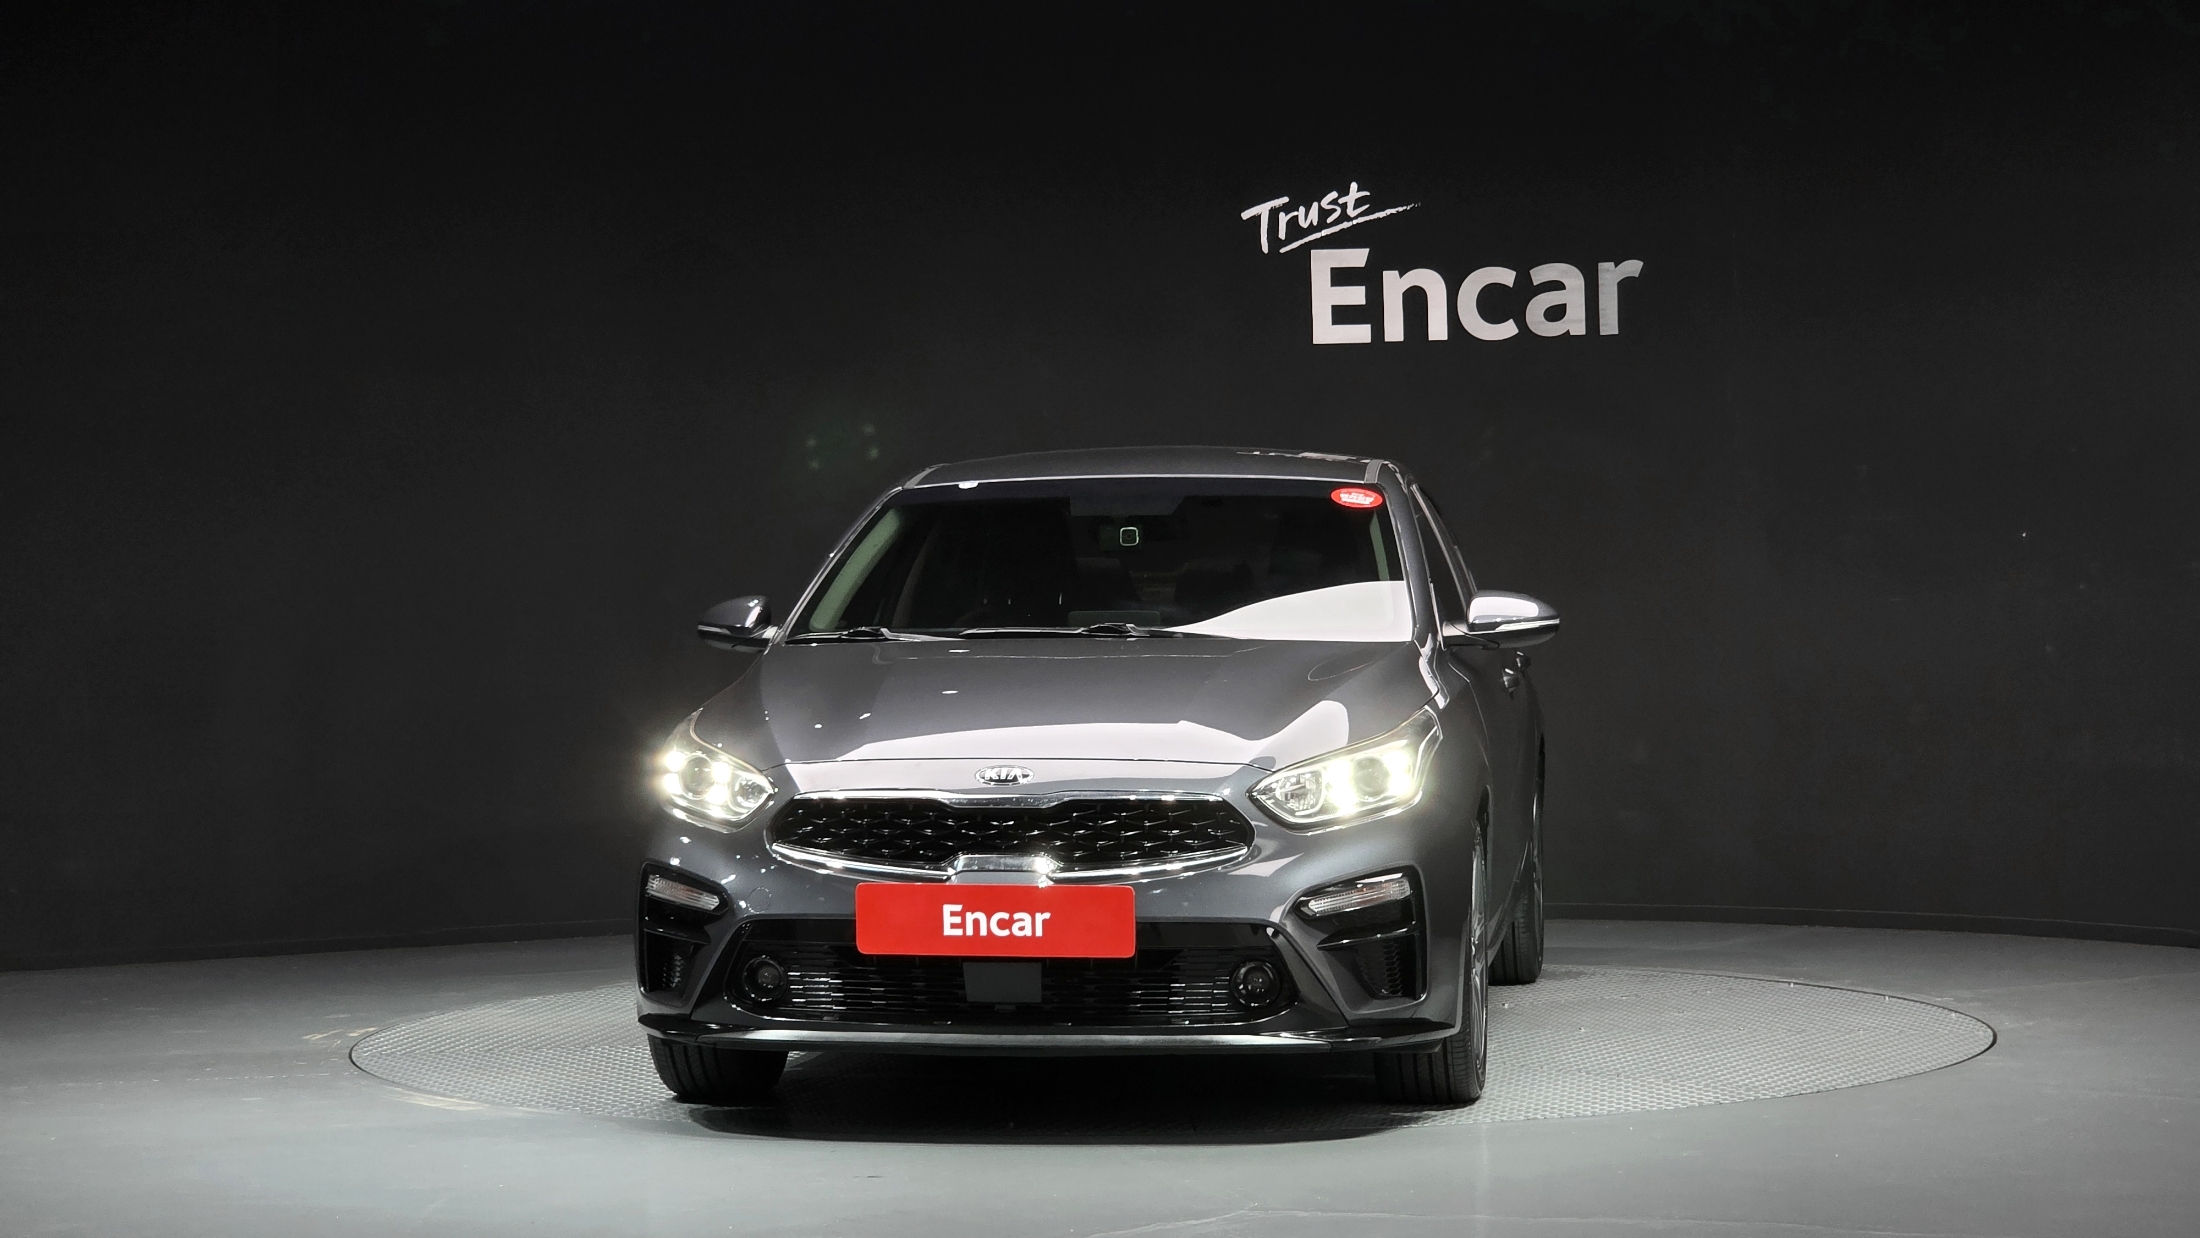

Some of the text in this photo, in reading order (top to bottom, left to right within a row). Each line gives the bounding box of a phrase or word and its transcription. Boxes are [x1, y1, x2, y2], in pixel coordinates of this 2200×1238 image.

[1241, 181, 1371, 254] Trust
[1310, 247, 1644, 345] Encar
[984, 767, 1023, 781] KIA
[941, 903, 1052, 938] Encar
